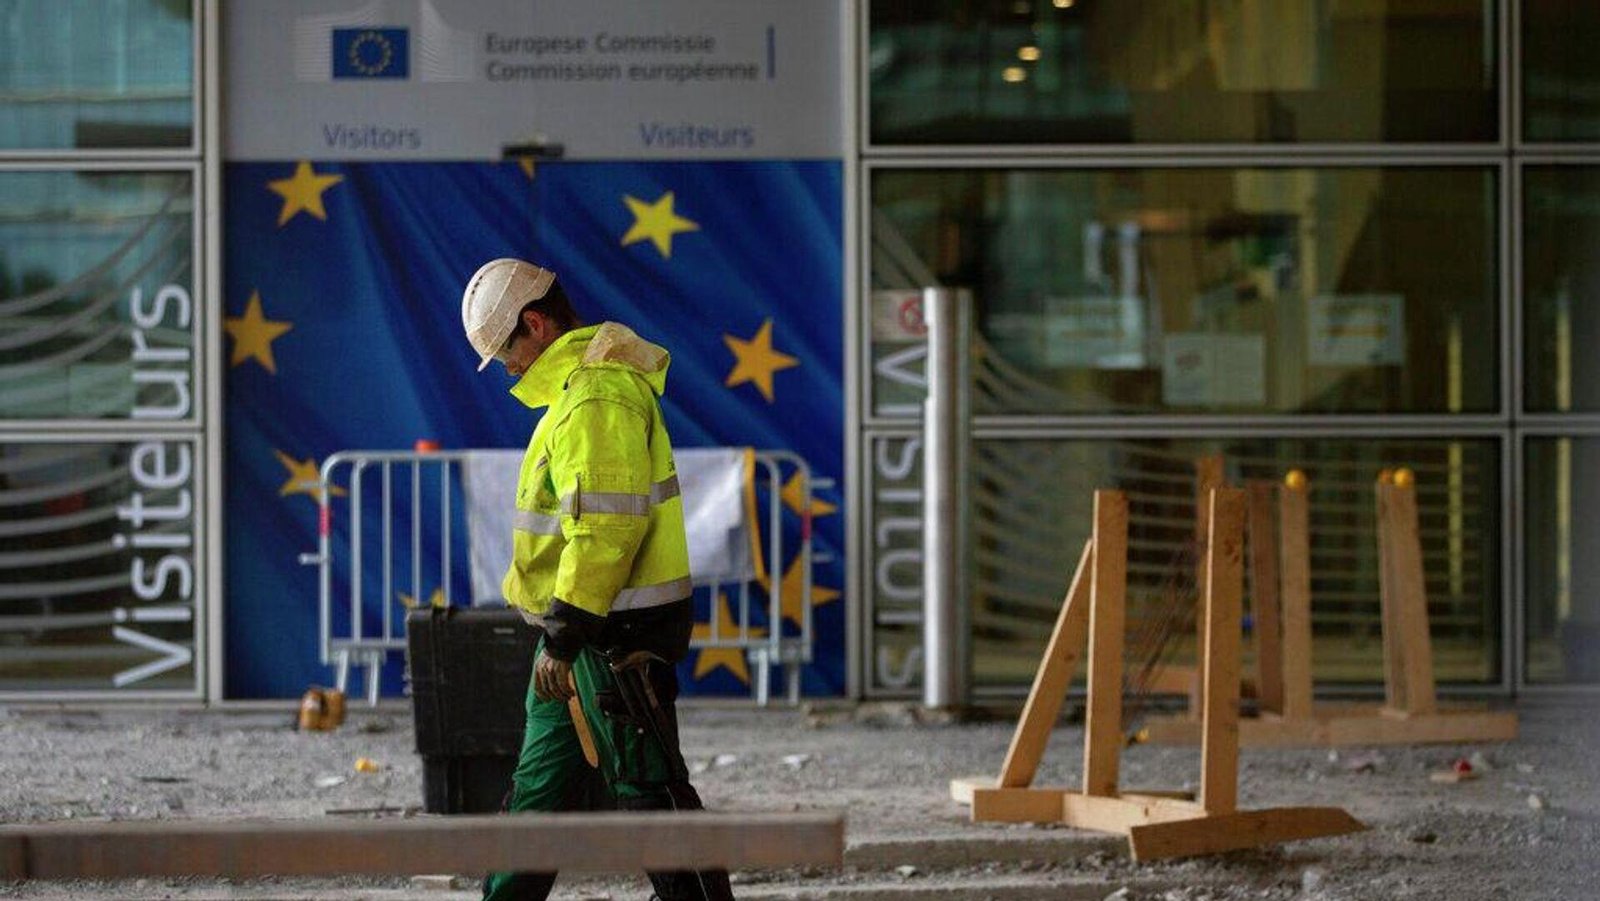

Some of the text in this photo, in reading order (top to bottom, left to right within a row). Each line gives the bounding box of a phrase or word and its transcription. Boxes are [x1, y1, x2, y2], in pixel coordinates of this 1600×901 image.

[486, 34, 715, 56] Europese Commissie
[486, 62, 760, 84] Commission européenne
[323, 123, 421, 149] Visitors
[640, 122, 755, 147] Visiteurs
[112, 284, 192, 687] Visiteurs
